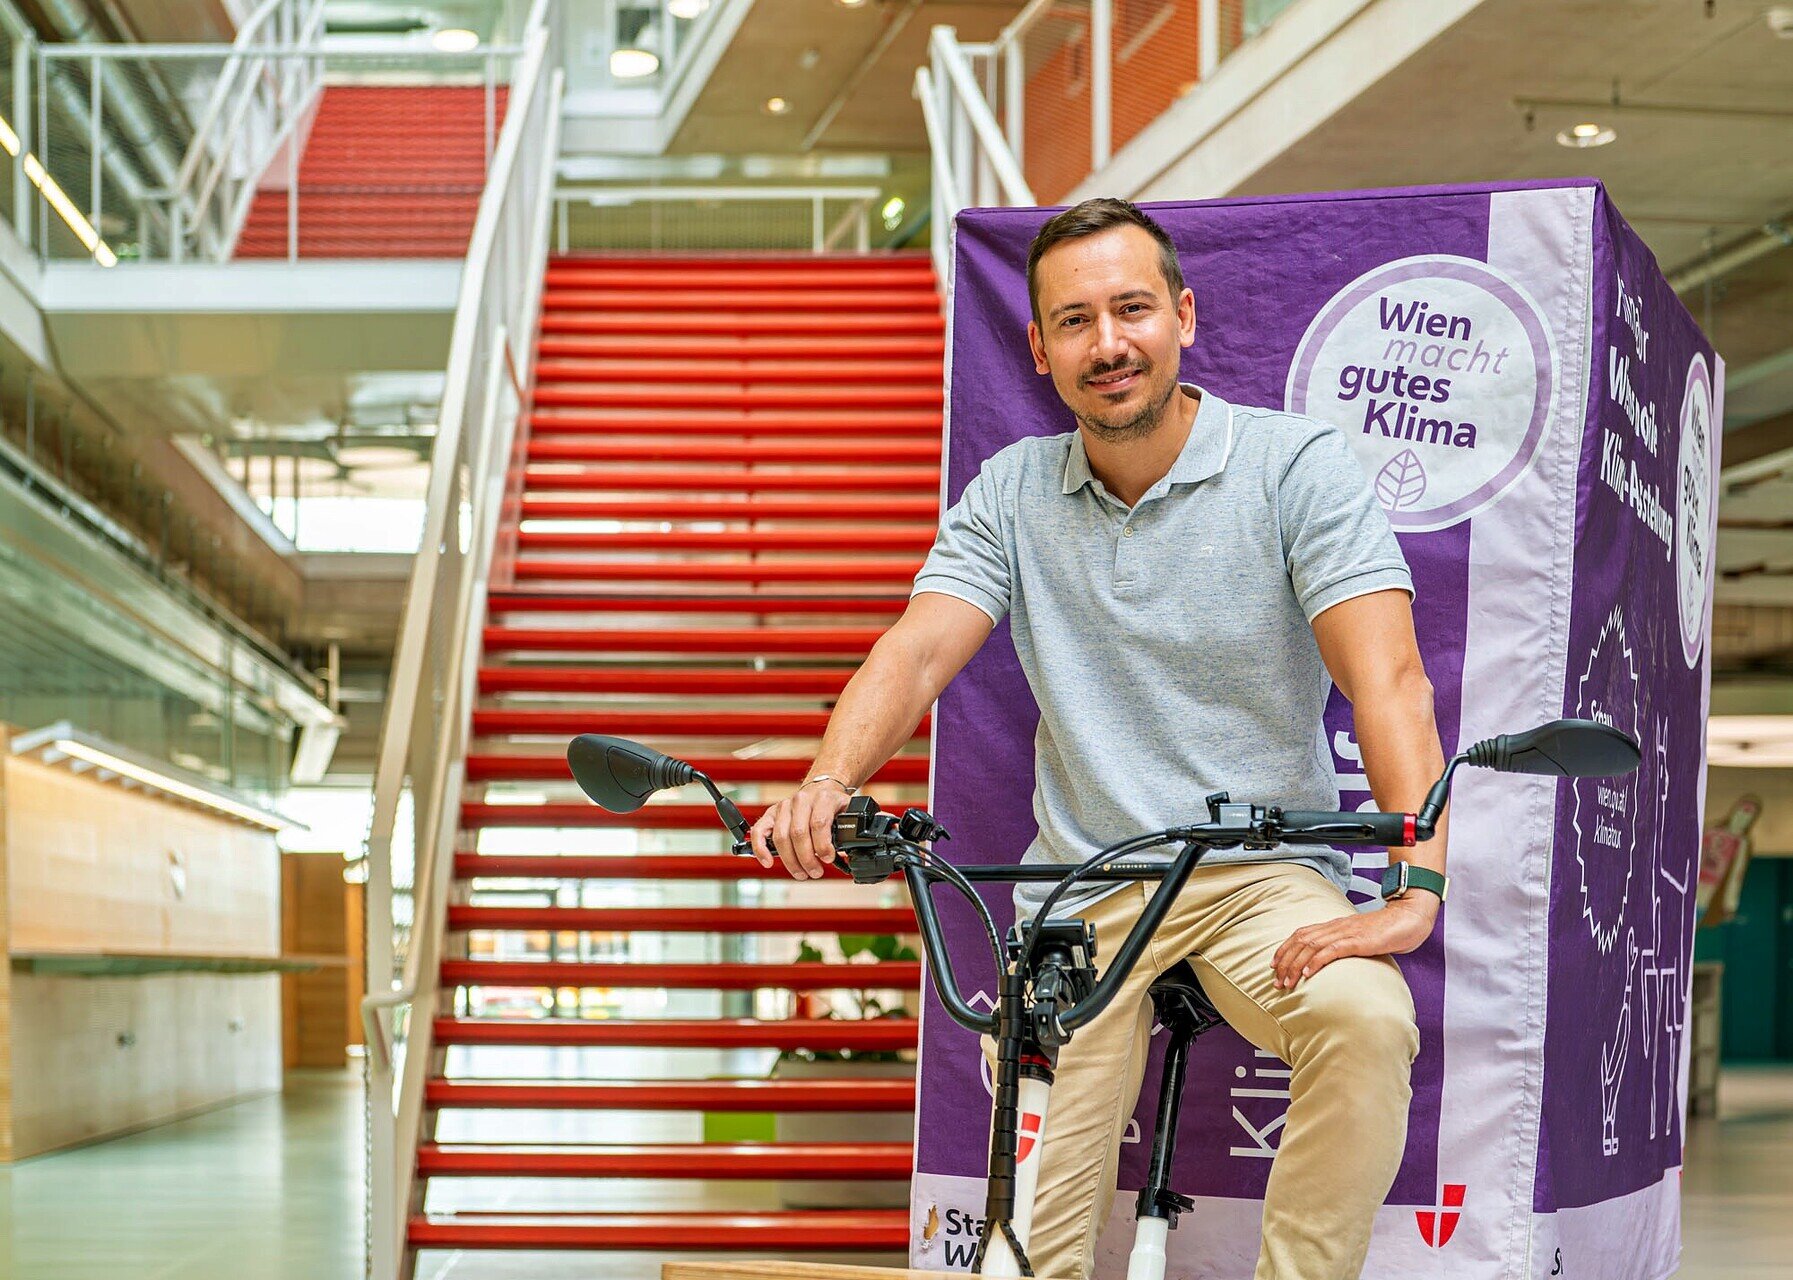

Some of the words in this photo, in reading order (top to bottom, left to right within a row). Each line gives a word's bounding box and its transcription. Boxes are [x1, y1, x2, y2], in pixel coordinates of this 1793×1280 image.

[1380, 297, 1472, 341] Wien
[1383, 338, 1509, 375] macht
[1337, 365, 1452, 404] gutes
[1363, 399, 1478, 449] Klima
